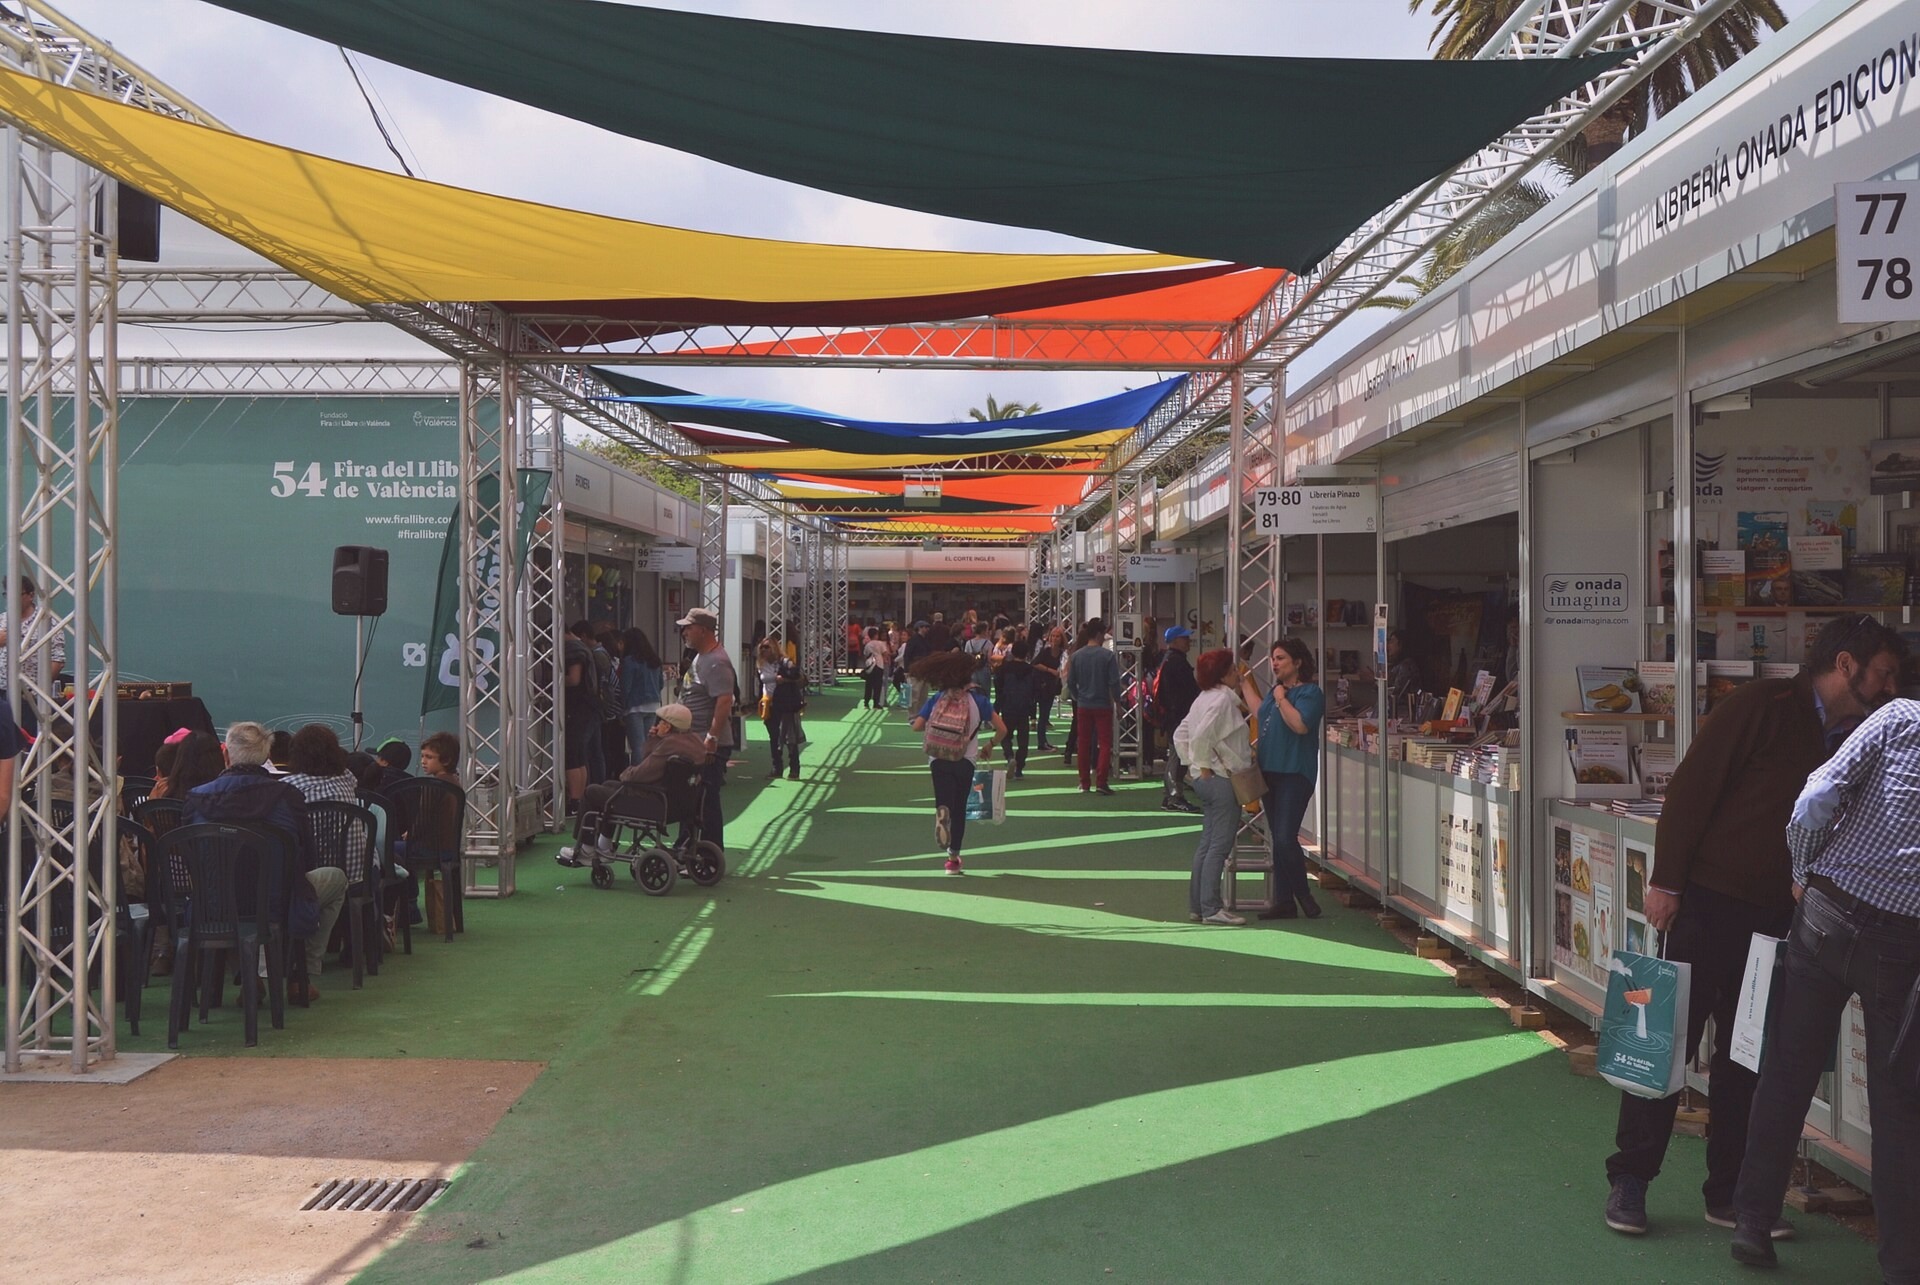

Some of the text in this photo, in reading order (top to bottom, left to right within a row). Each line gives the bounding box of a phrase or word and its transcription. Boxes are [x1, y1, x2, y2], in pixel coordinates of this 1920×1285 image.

[1655, 32, 1920, 230] LIBRERÍA ONADA EDICION
[1855, 192, 1907, 235] 77
[1857, 257, 1913, 301] 78
[319, 411, 348, 419] Fundació
[334, 459, 460, 478] Fira del Llib
[270, 460, 328, 498] 54
[333, 480, 457, 498] de València
[1309, 490, 1360, 499] Librería Pinazo
[1668, 483, 1723, 496] oda
[1262, 513, 1279, 529] 81
[637, 548, 649, 557] 96
[1095, 555, 1105, 563] 83
[637, 559, 648, 569] 97
[1130, 556, 1141, 566] 82
[1096, 565, 1107, 574] 84
[1574, 578, 1622, 590] onada
[1550, 591, 1622, 611] imagina
[1555, 617, 1629, 626] onadaimagina.com
[1613, 1052, 1627, 1065] 54
